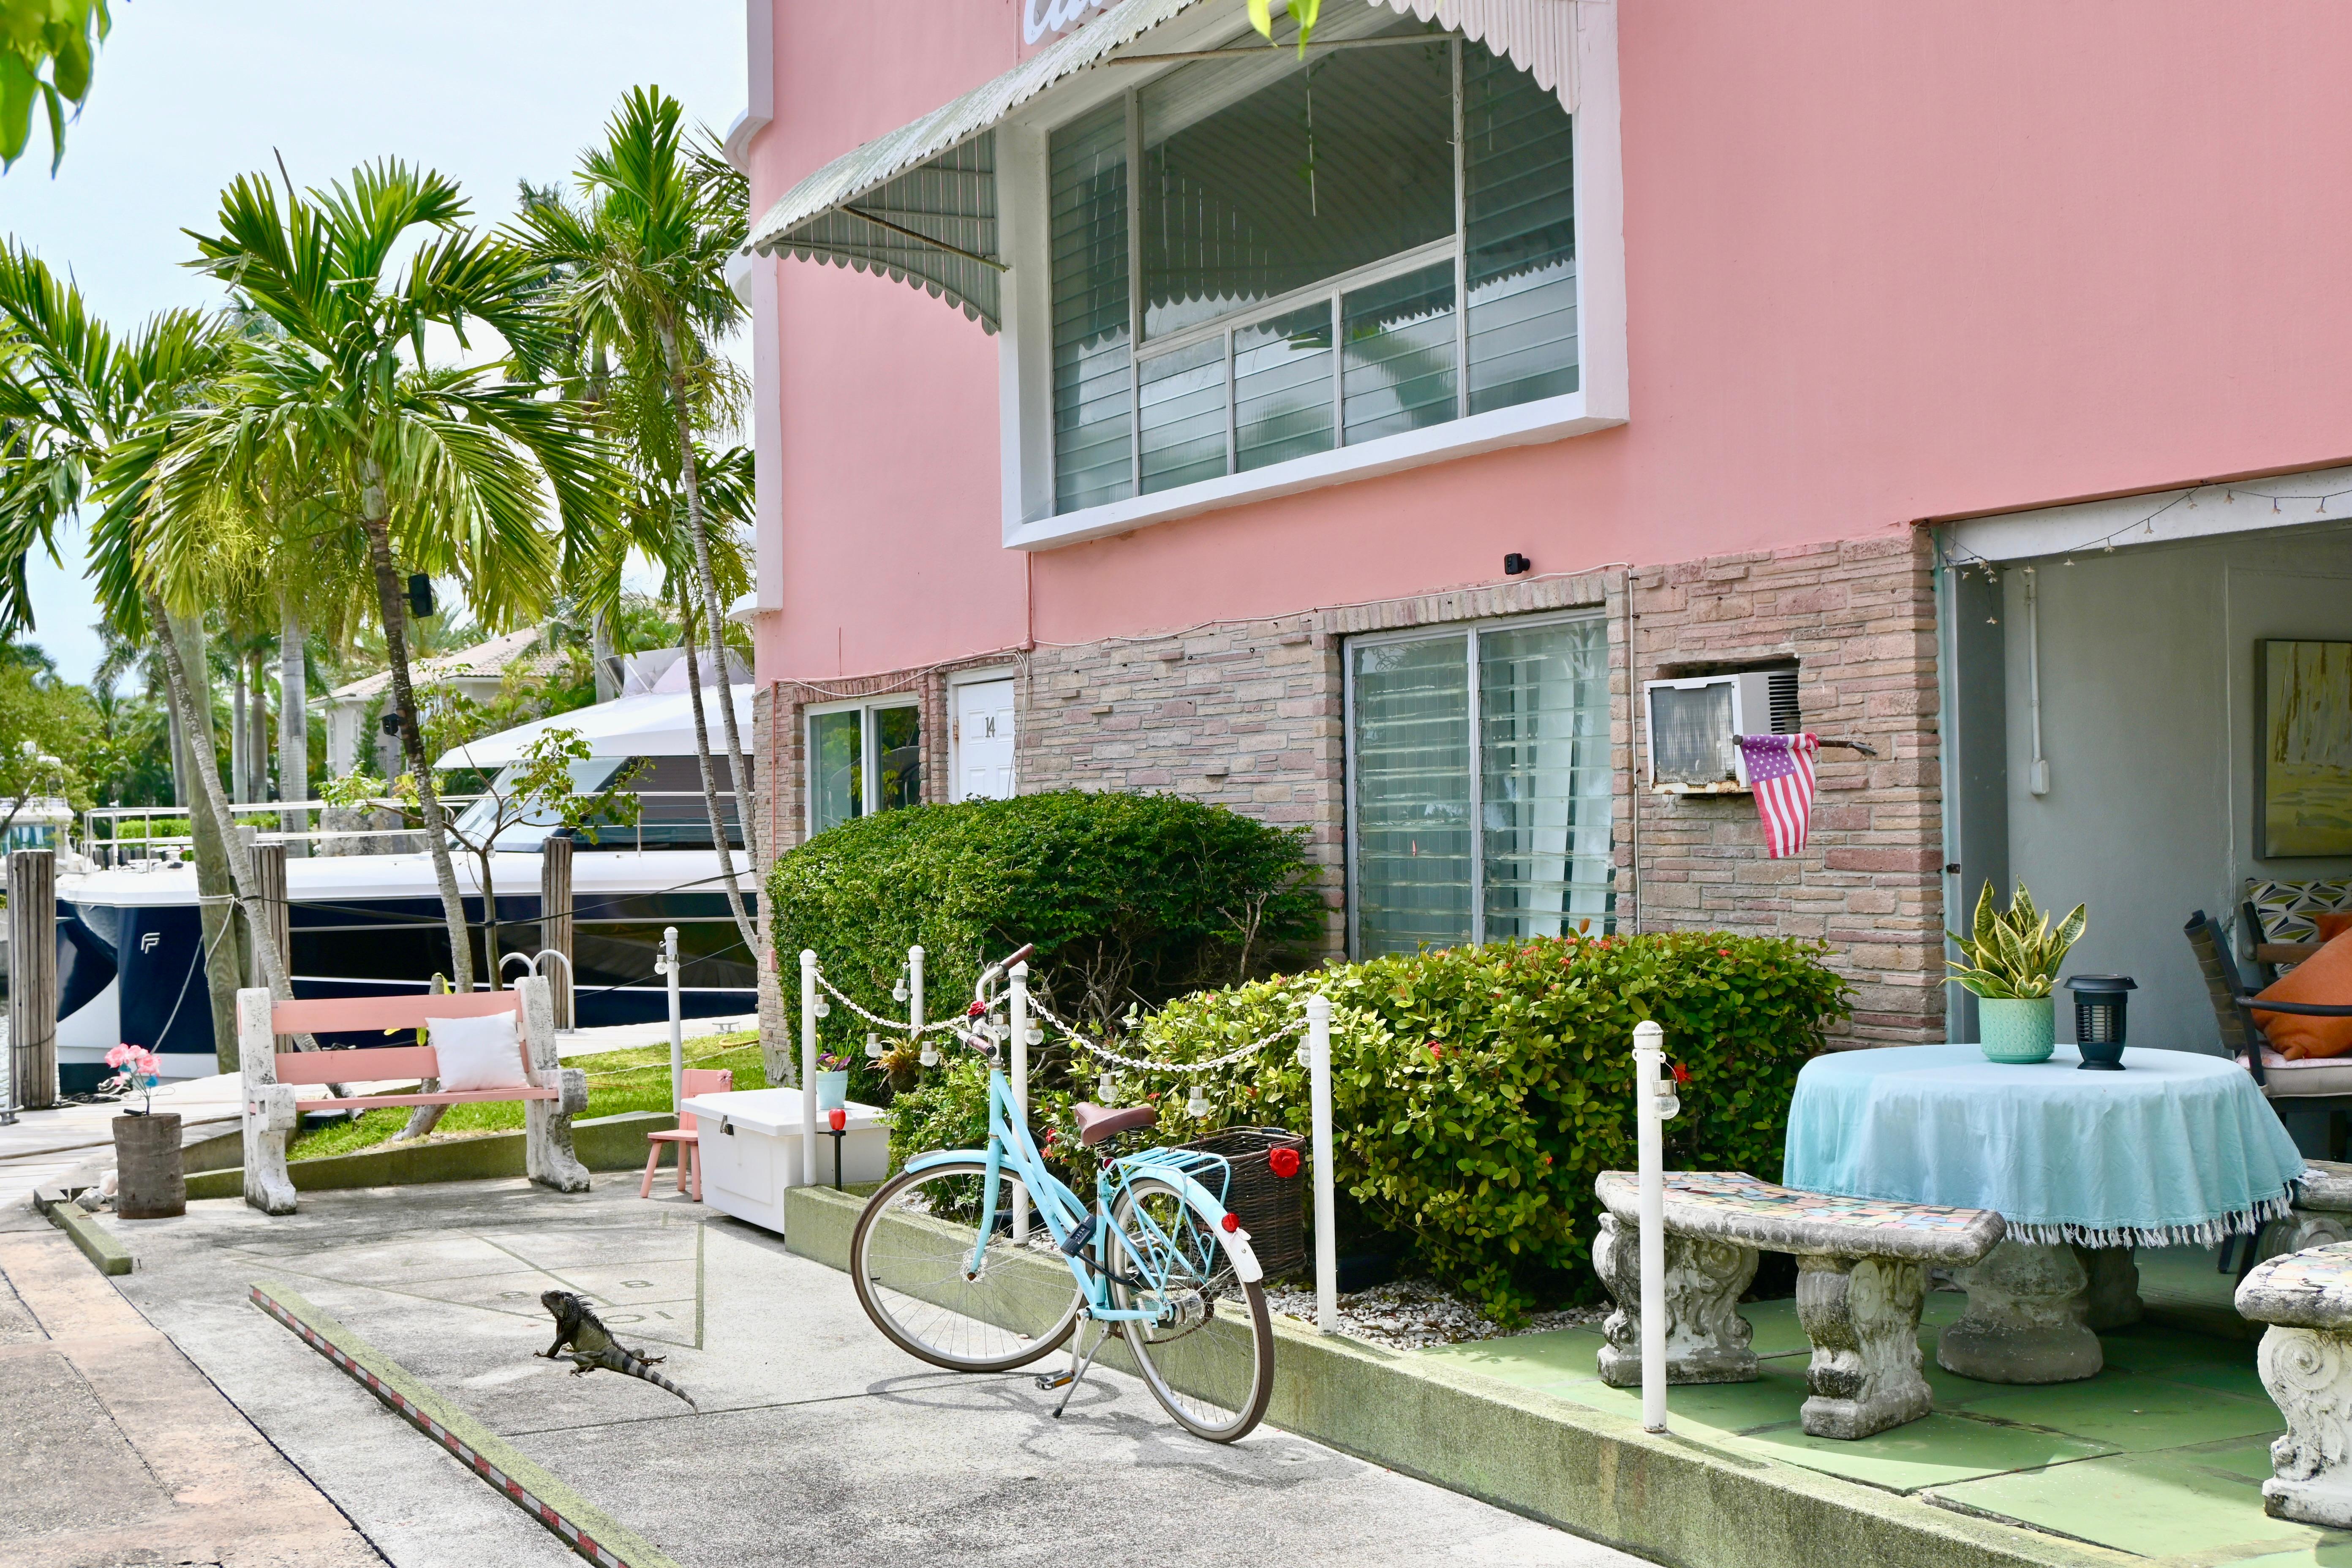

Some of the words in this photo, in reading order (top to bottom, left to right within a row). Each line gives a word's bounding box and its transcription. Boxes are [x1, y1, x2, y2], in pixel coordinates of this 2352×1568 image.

[985, 716, 996, 738] 14
[496, 1291, 531, 1299] 8
[600, 1310, 675, 1324] 10
